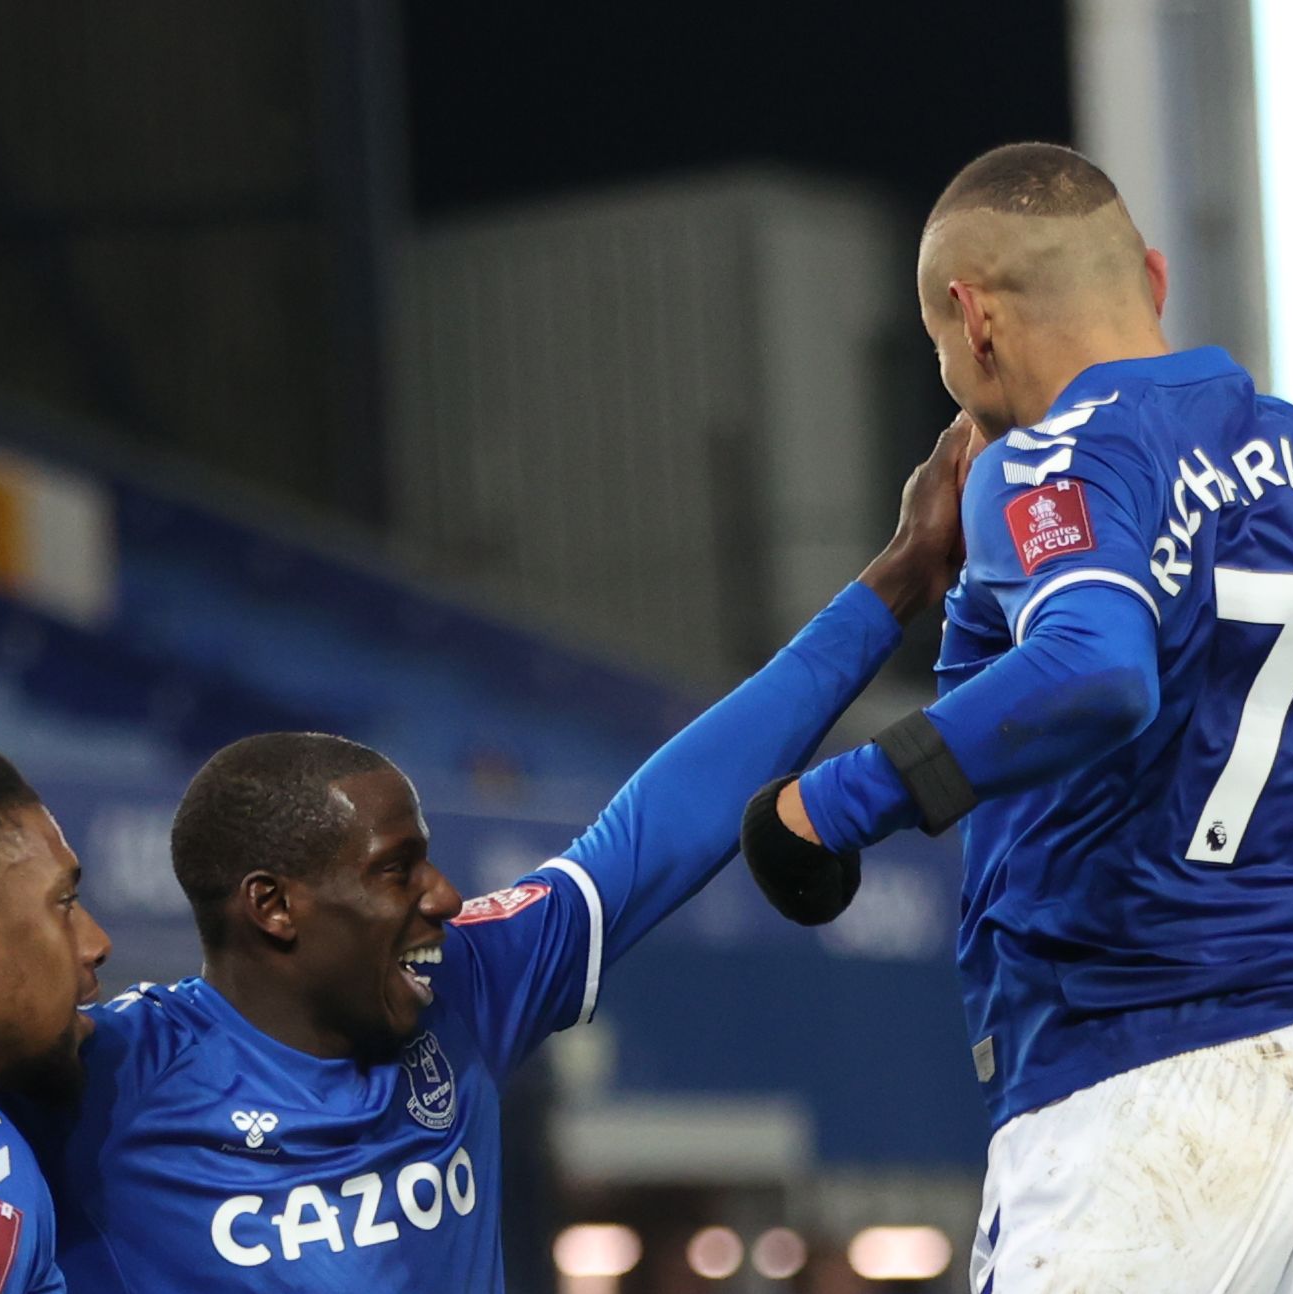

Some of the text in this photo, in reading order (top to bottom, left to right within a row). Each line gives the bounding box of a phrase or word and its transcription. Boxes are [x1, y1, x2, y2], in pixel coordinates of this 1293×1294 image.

[1023, 525, 1080, 553] Emirates
[1025, 533, 1082, 564] FA CUP
[211, 1146, 477, 1267] CAZOO
